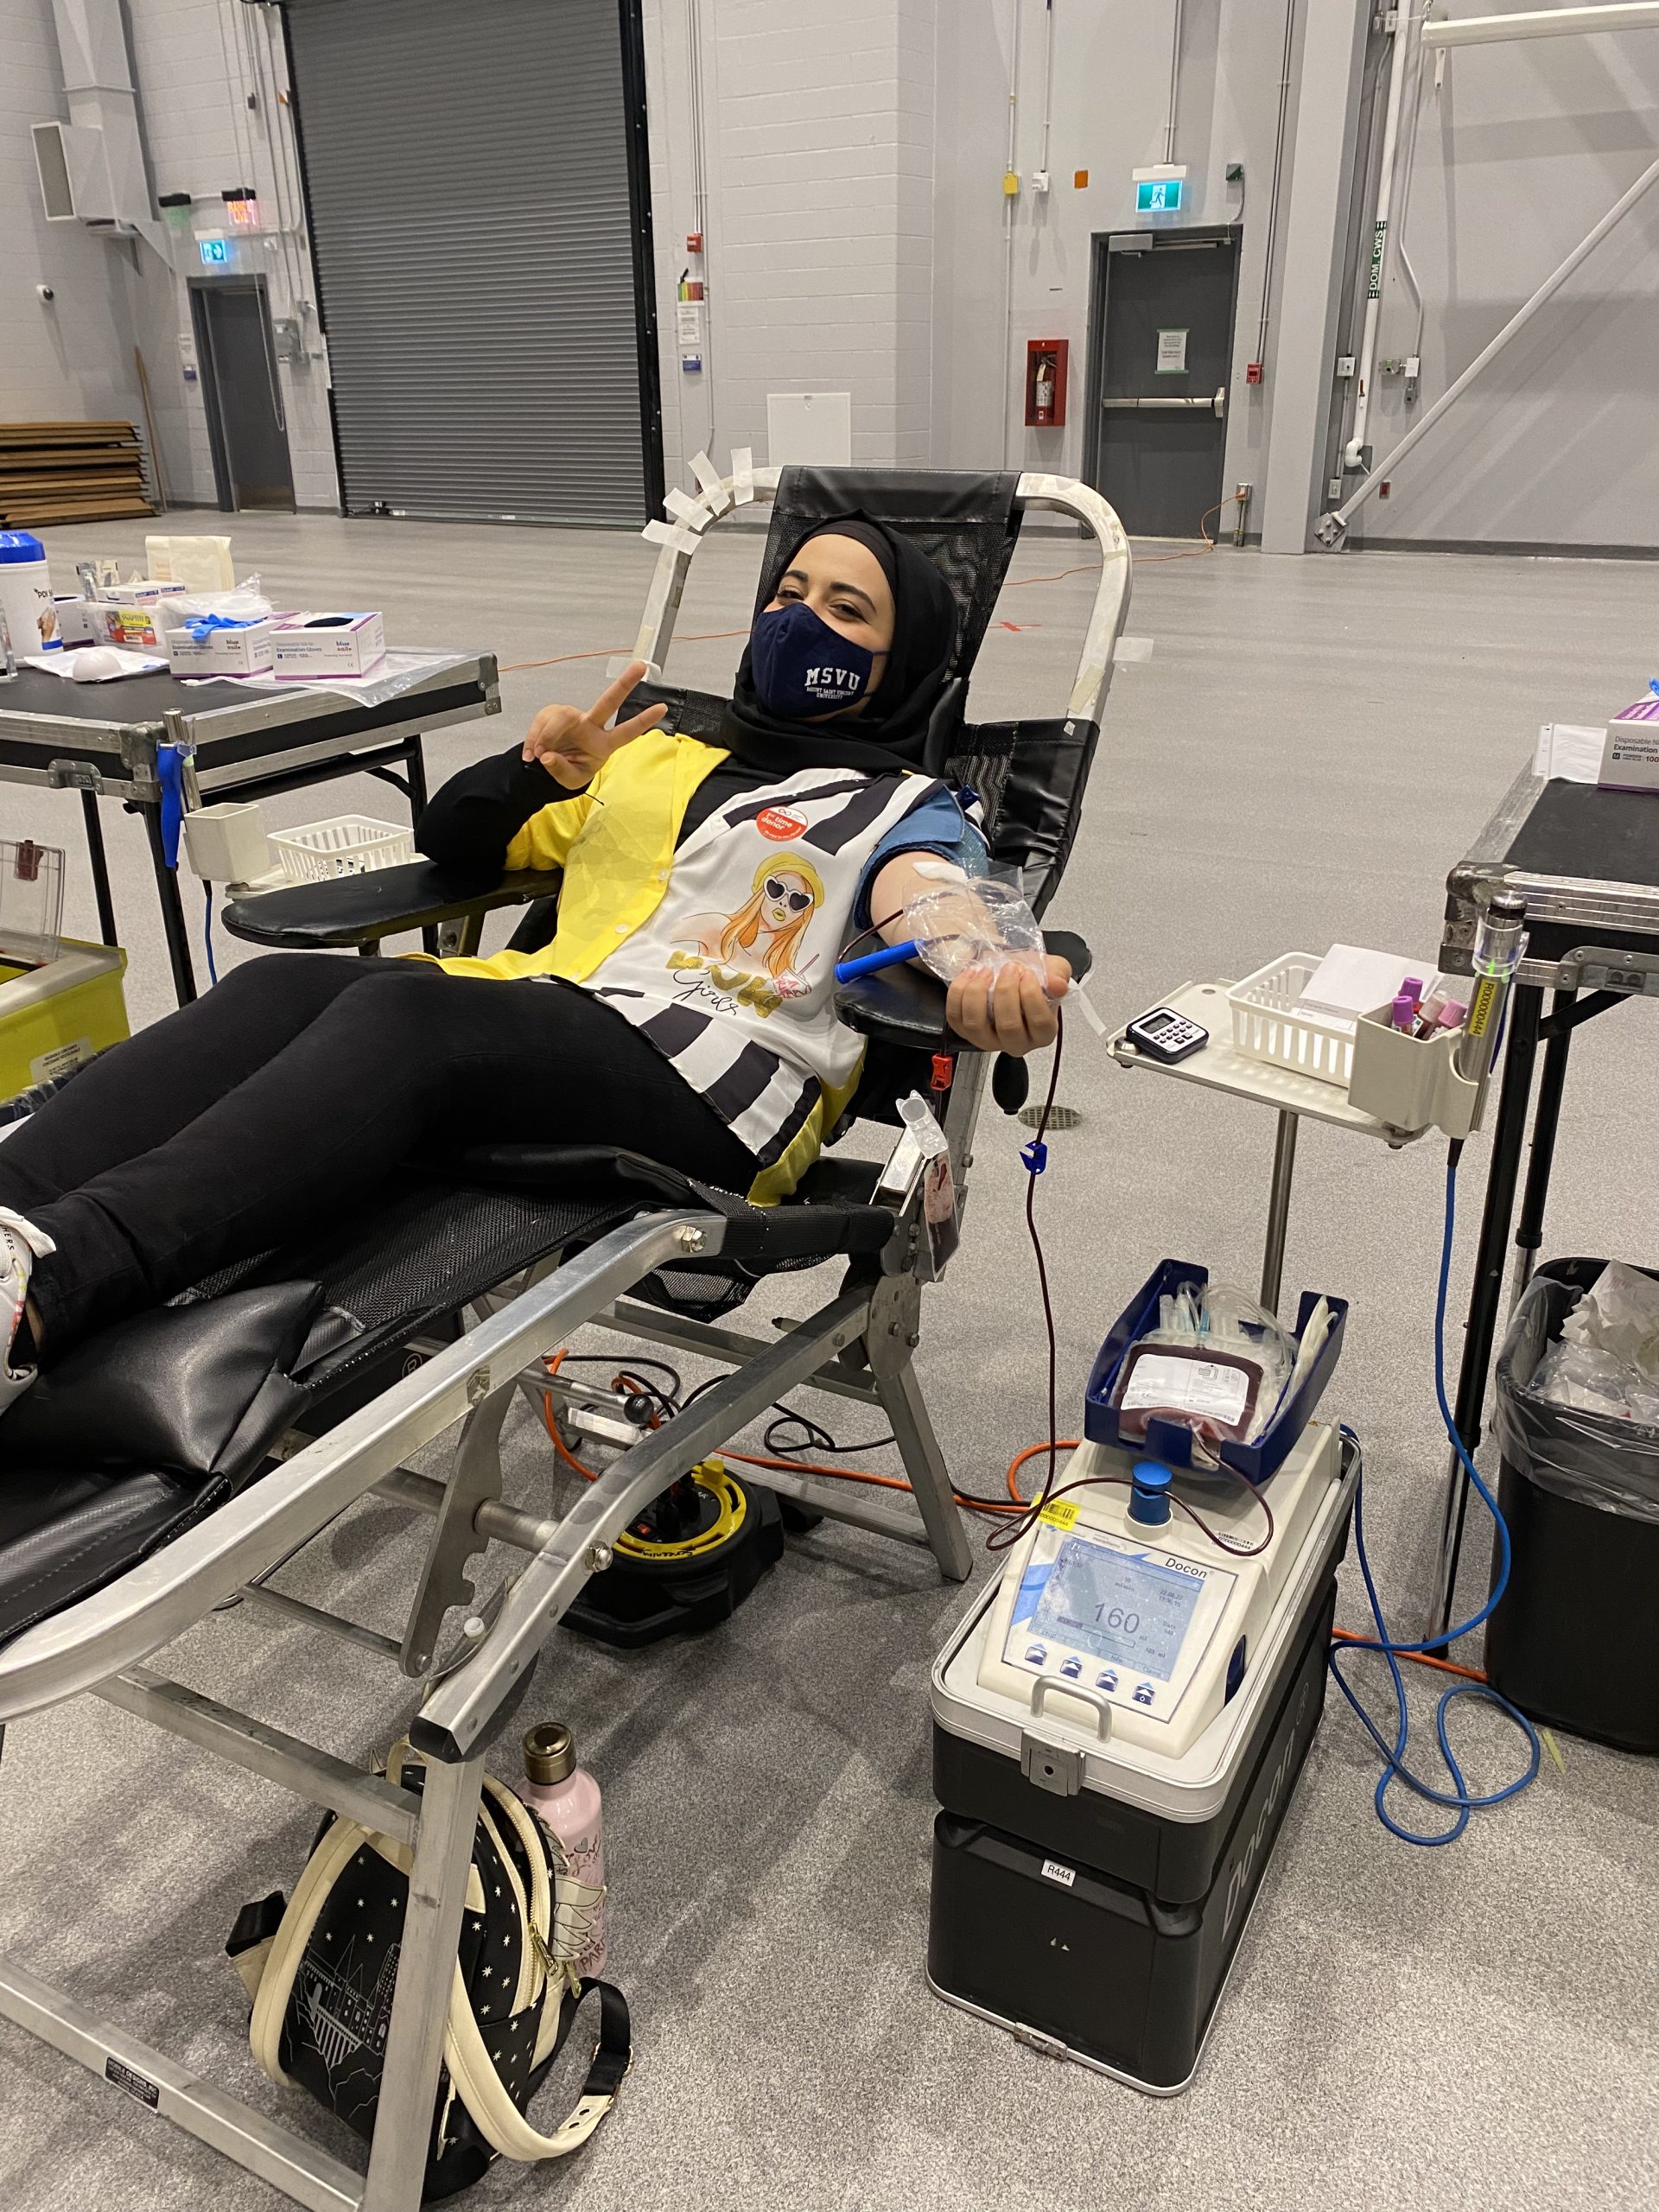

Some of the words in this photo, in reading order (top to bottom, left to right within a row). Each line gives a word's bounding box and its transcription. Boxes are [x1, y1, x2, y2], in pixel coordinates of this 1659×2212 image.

[1372, 230, 1383, 257] CWS
[1370, 261, 1380, 290] DOM.
[804, 667, 861, 691] MSVU
[1613, 744, 1658, 753] Examination
[1615, 736, 1651, 745] Disposable
[761, 817, 785, 830] donor
[775, 817, 793, 828] time
[673, 969, 739, 1016] Girls
[1473, 982, 1494, 1035] R000000444
[1165, 1558, 1207, 1579] Docon
[1095, 1603, 1140, 1634] 160
[1222, 1727, 1295, 1942] Docon
[1047, 1865, 1071, 1881] R444
